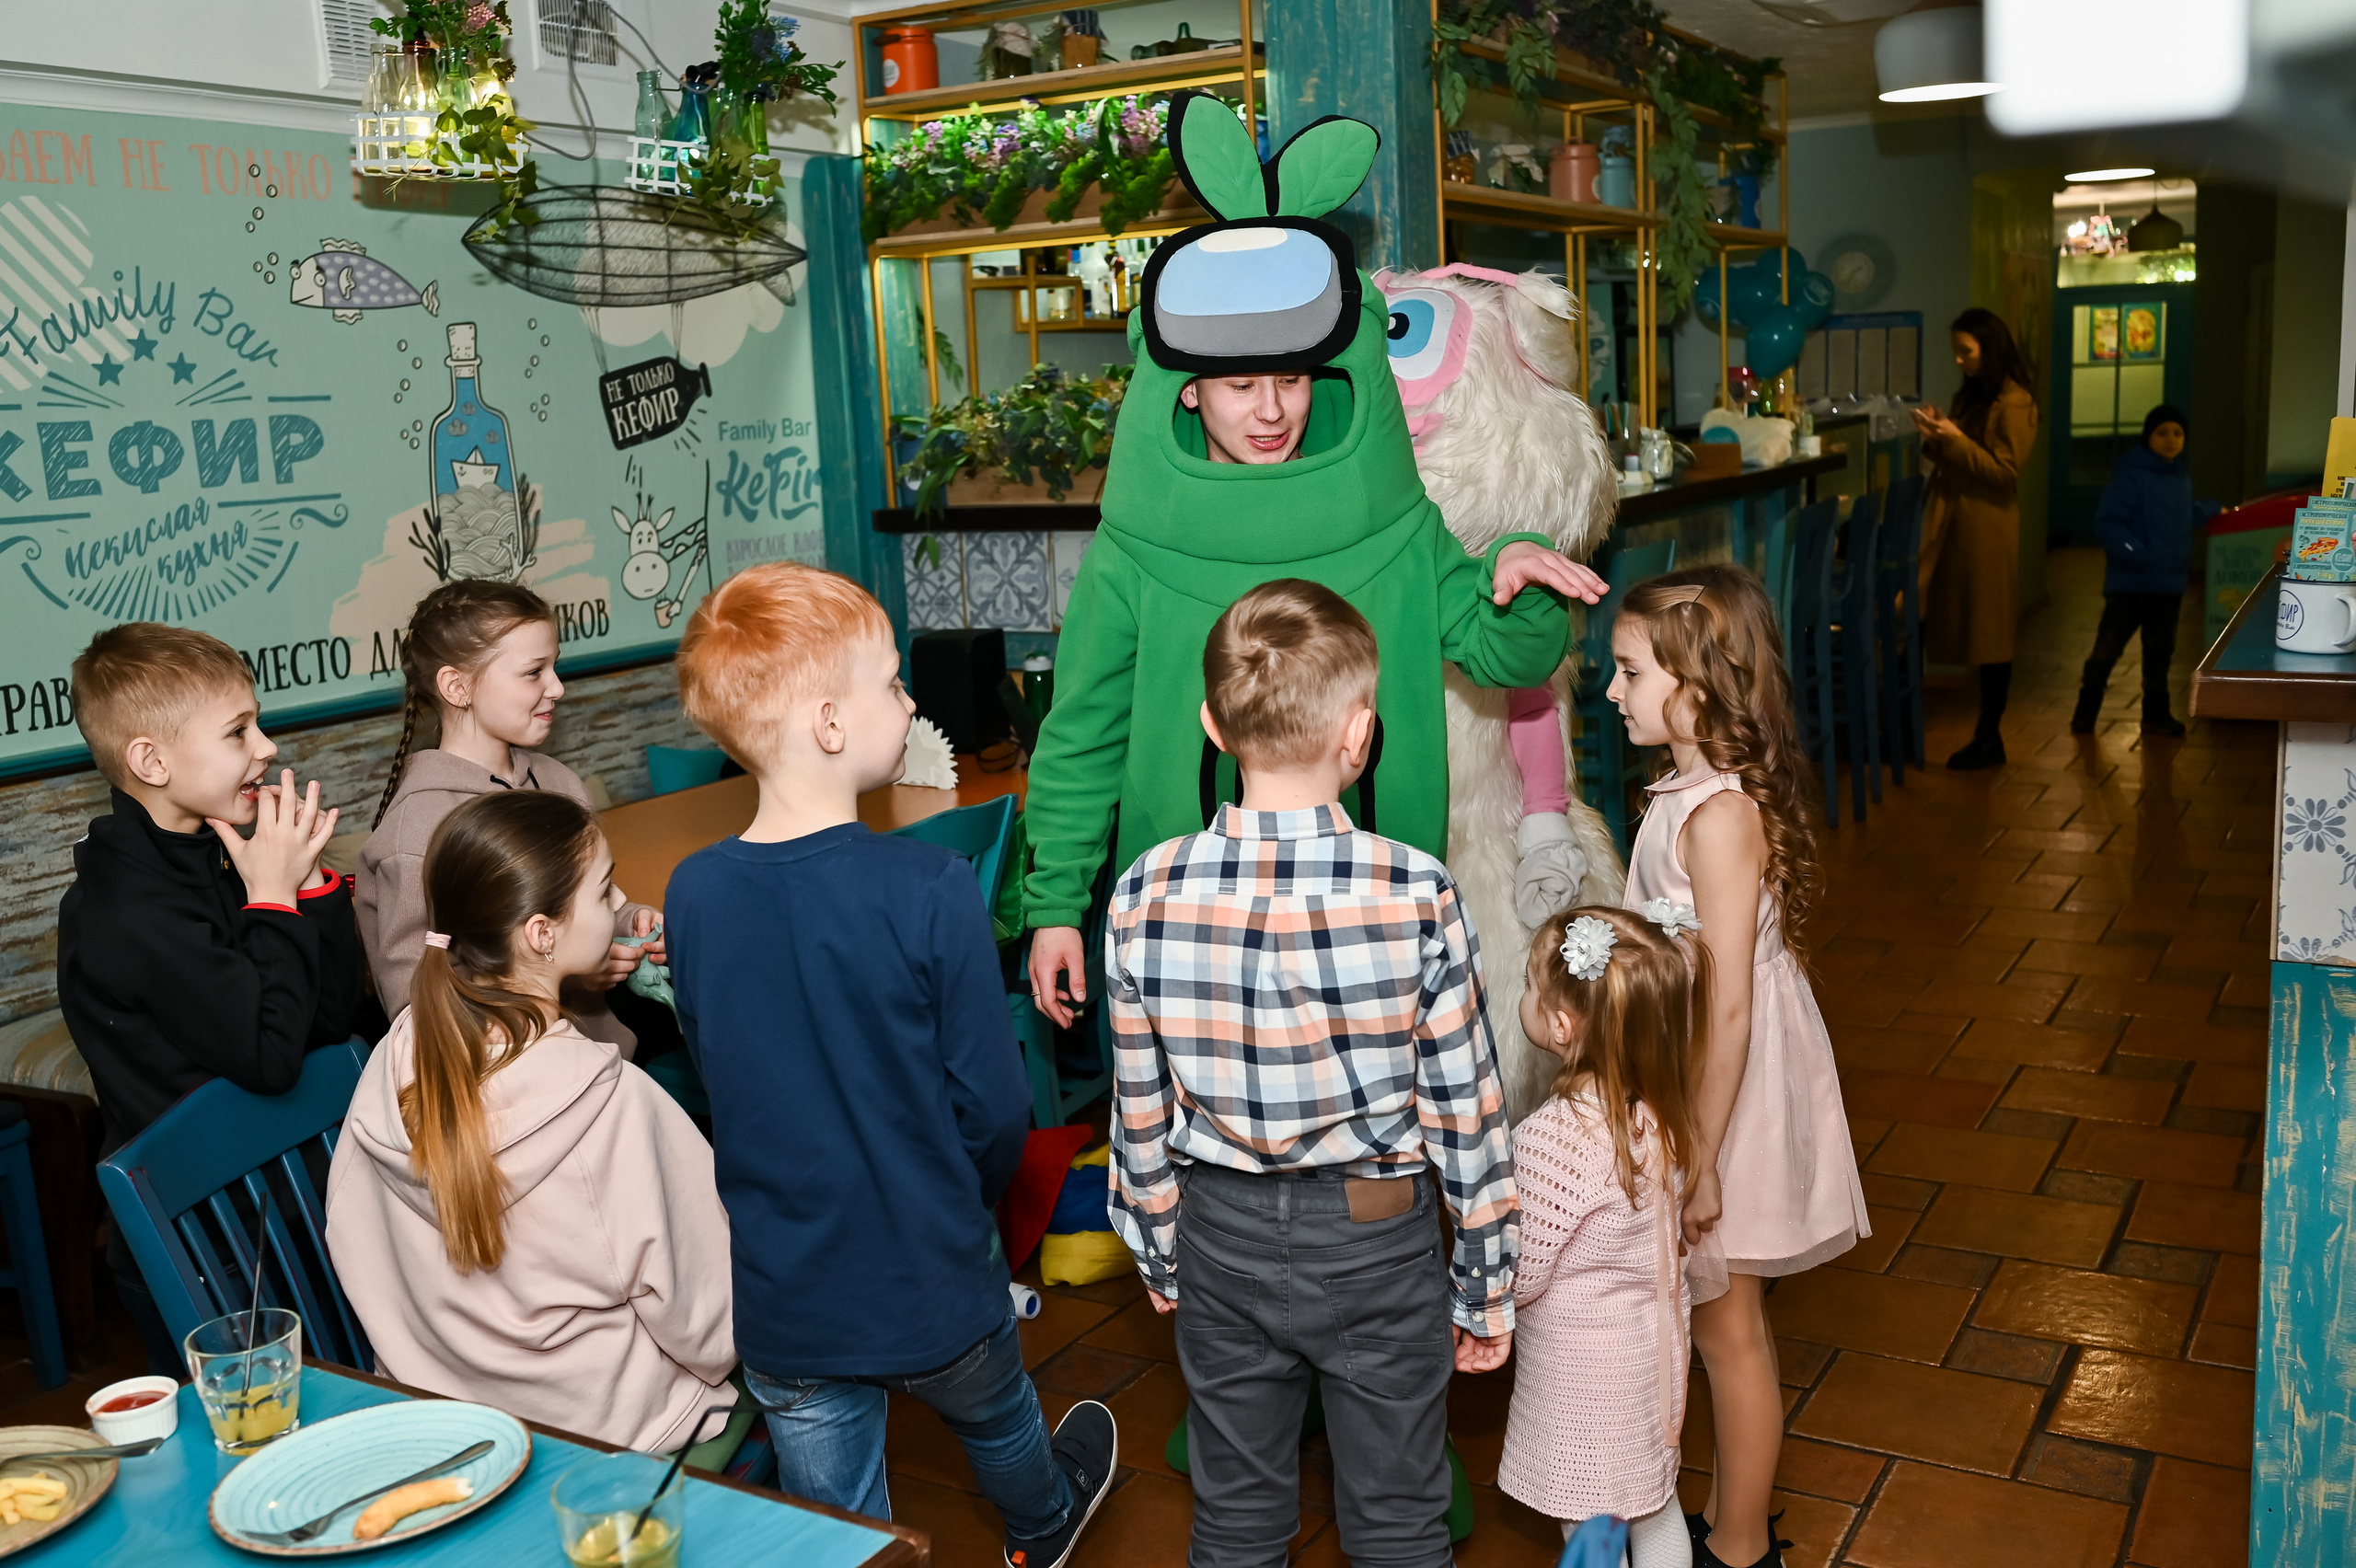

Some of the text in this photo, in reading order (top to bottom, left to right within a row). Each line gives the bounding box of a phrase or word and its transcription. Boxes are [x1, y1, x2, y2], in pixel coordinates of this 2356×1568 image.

[0, 128, 98, 187] АЕМ
[118, 137, 171, 191] НЕ
[188, 144, 331, 201] ТОЛЬКО
[193, 286, 279, 368] Bar
[605, 362, 676, 403] НЕ ТОЛЬКО
[611, 386, 679, 442] КЕФИР
[718, 418, 812, 444] Family Bar
[65, 496, 210, 580] некислая
[157, 519, 248, 587] кухня
[238, 636, 352, 693] МЕСТО
[369, 628, 404, 681] ДЛ
[554, 598, 609, 643] КОВ
